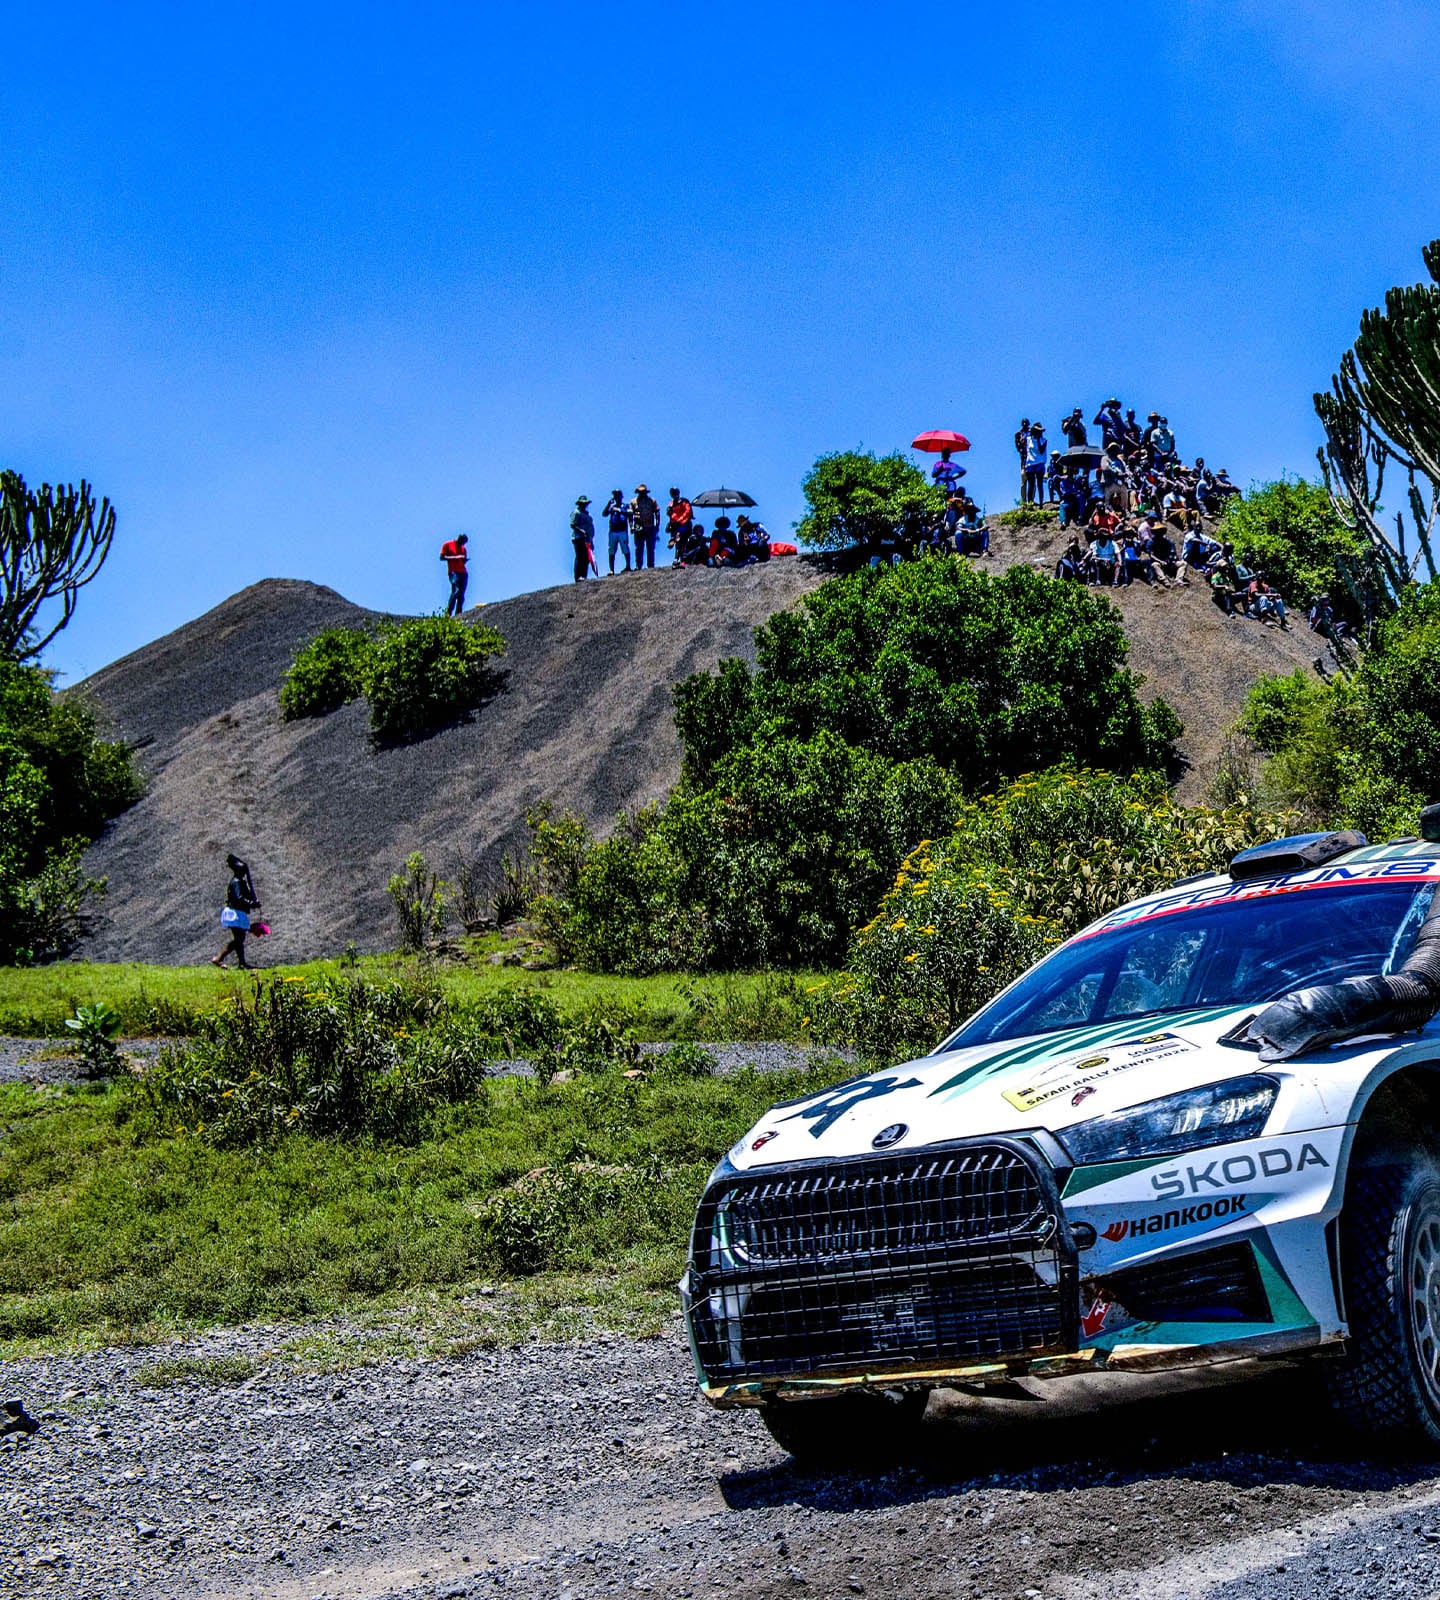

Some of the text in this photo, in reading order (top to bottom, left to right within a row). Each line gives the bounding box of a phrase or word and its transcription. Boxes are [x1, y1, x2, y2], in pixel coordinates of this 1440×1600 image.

[1140, 1034, 1168, 1044] 22
[1026, 1084, 1071, 1106] SAFARI
[1073, 1070, 1109, 1087] RALLY
[1112, 1057, 1154, 1073] KENYA
[1155, 1047, 1190, 1060] 2026
